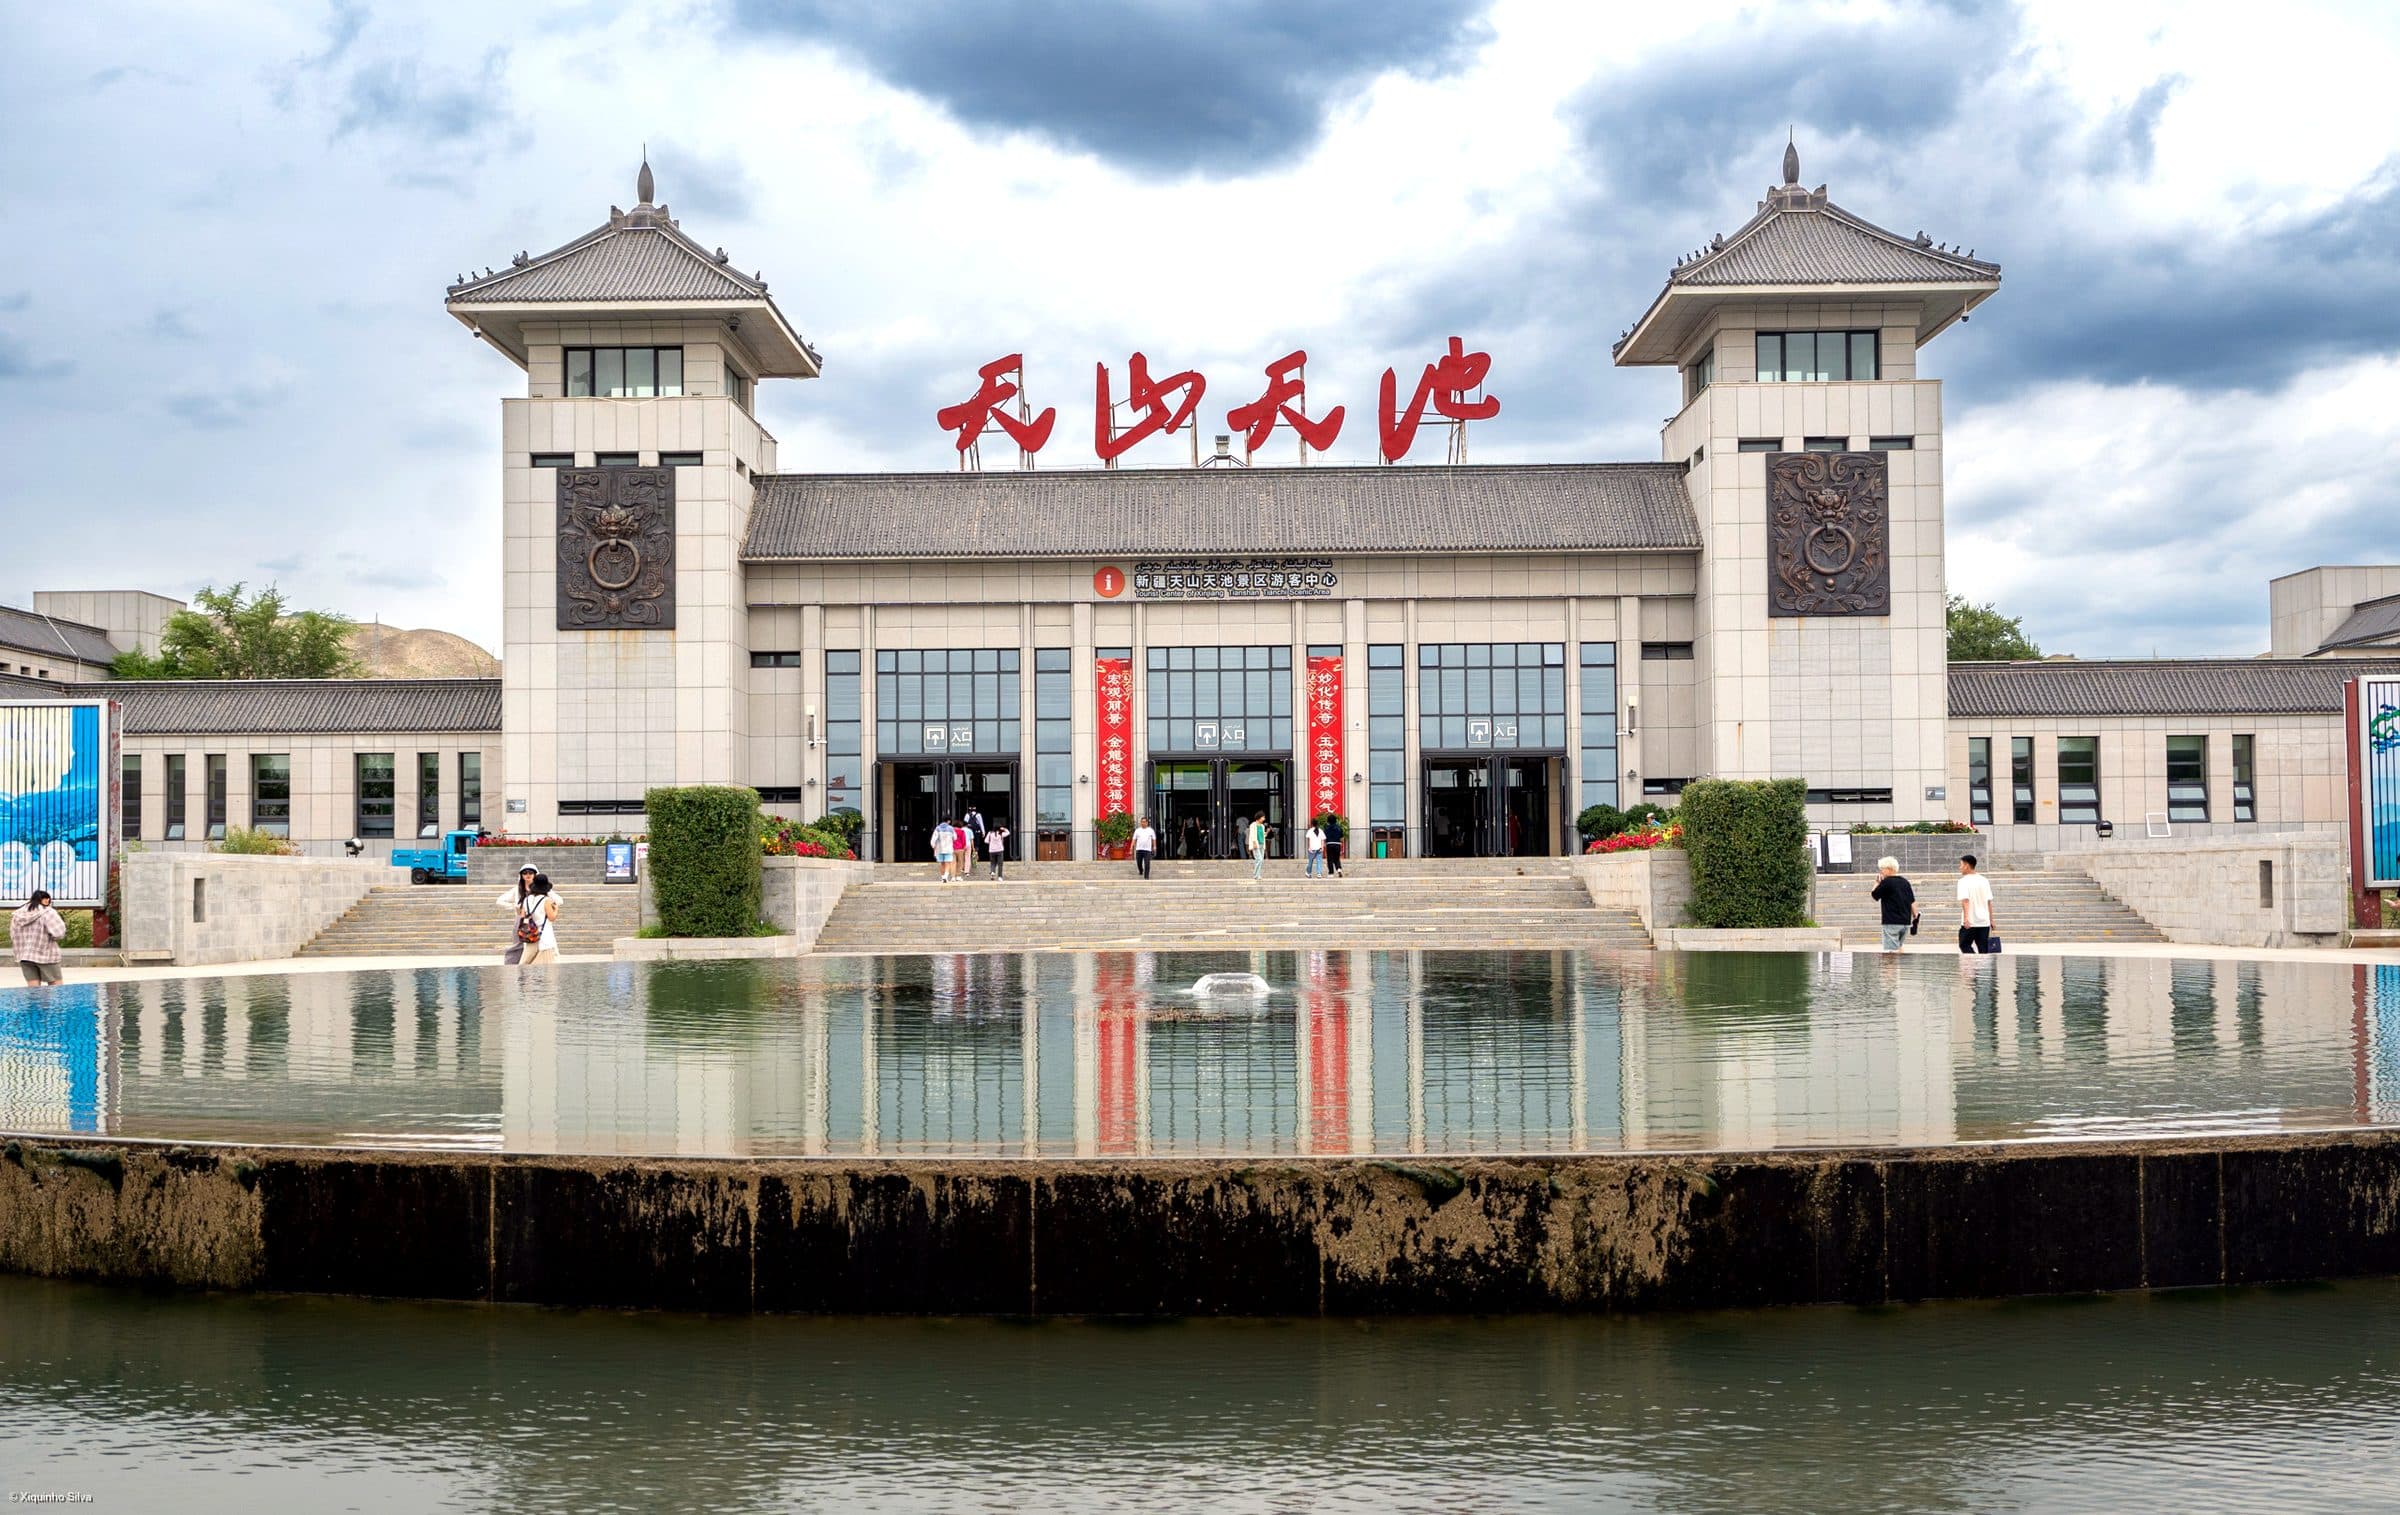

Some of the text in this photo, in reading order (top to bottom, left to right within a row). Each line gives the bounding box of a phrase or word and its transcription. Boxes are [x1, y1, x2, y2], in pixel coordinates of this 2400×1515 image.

[937, 336, 1500, 461] 天山天池
[1135, 573, 1337, 588] 新疆天山天池景区游客中心
[1135, 589, 1159, 597] Tourist
[1160, 589, 1185, 598] Center
[1228, 588, 1260, 597] Tianshan
[1288, 588, 1312, 596] Scenic
[1313, 588, 1330, 596] Area
[950, 731, 972, 742] 入口
[1221, 729, 1244, 740] 入口
[1494, 725, 1517, 737] 入口
